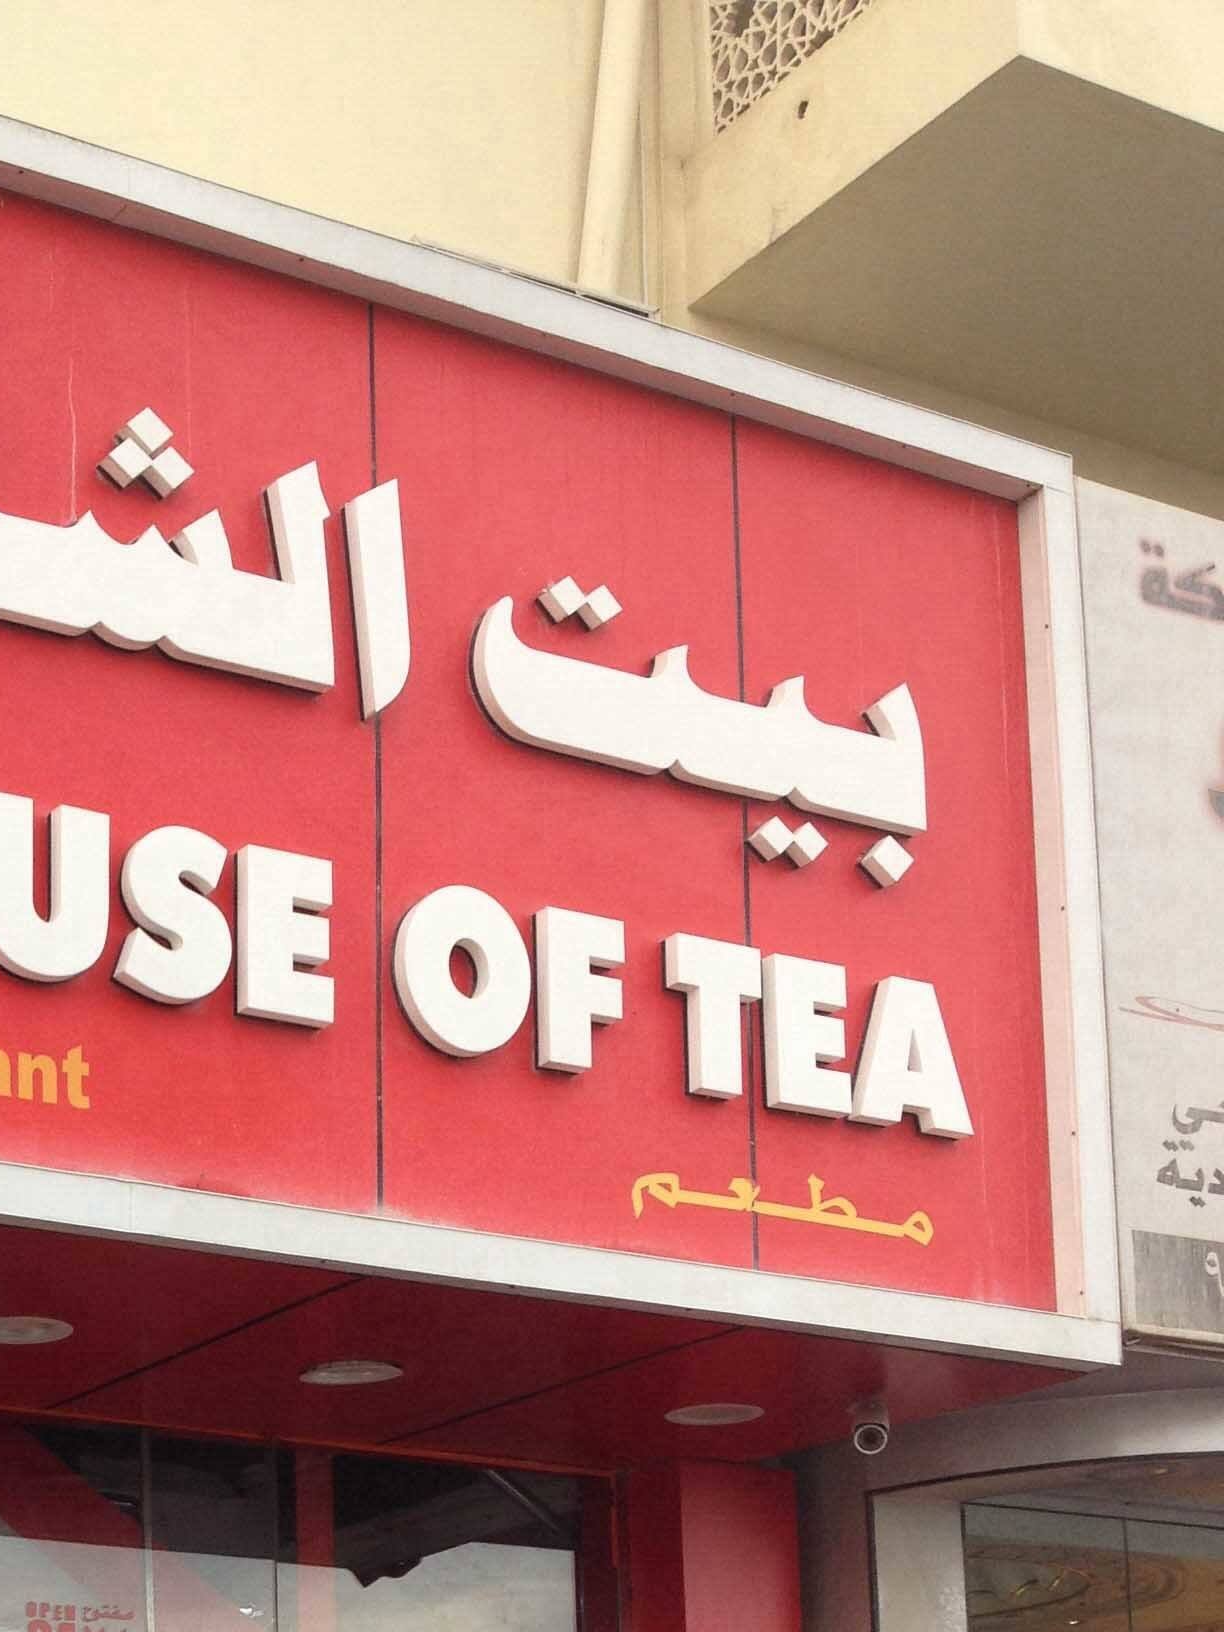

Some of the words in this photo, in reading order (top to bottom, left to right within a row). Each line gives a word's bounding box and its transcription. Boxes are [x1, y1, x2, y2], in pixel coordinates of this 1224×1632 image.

[471, 575, 929, 888] بيت
[393, 885, 626, 1072] OF
[665, 932, 974, 1138] TEA
[631, 1172, 935, 1247] مطعم
[25, 1601, 76, 1622] OPEN
[80, 1604, 136, 1623] مفتوح
